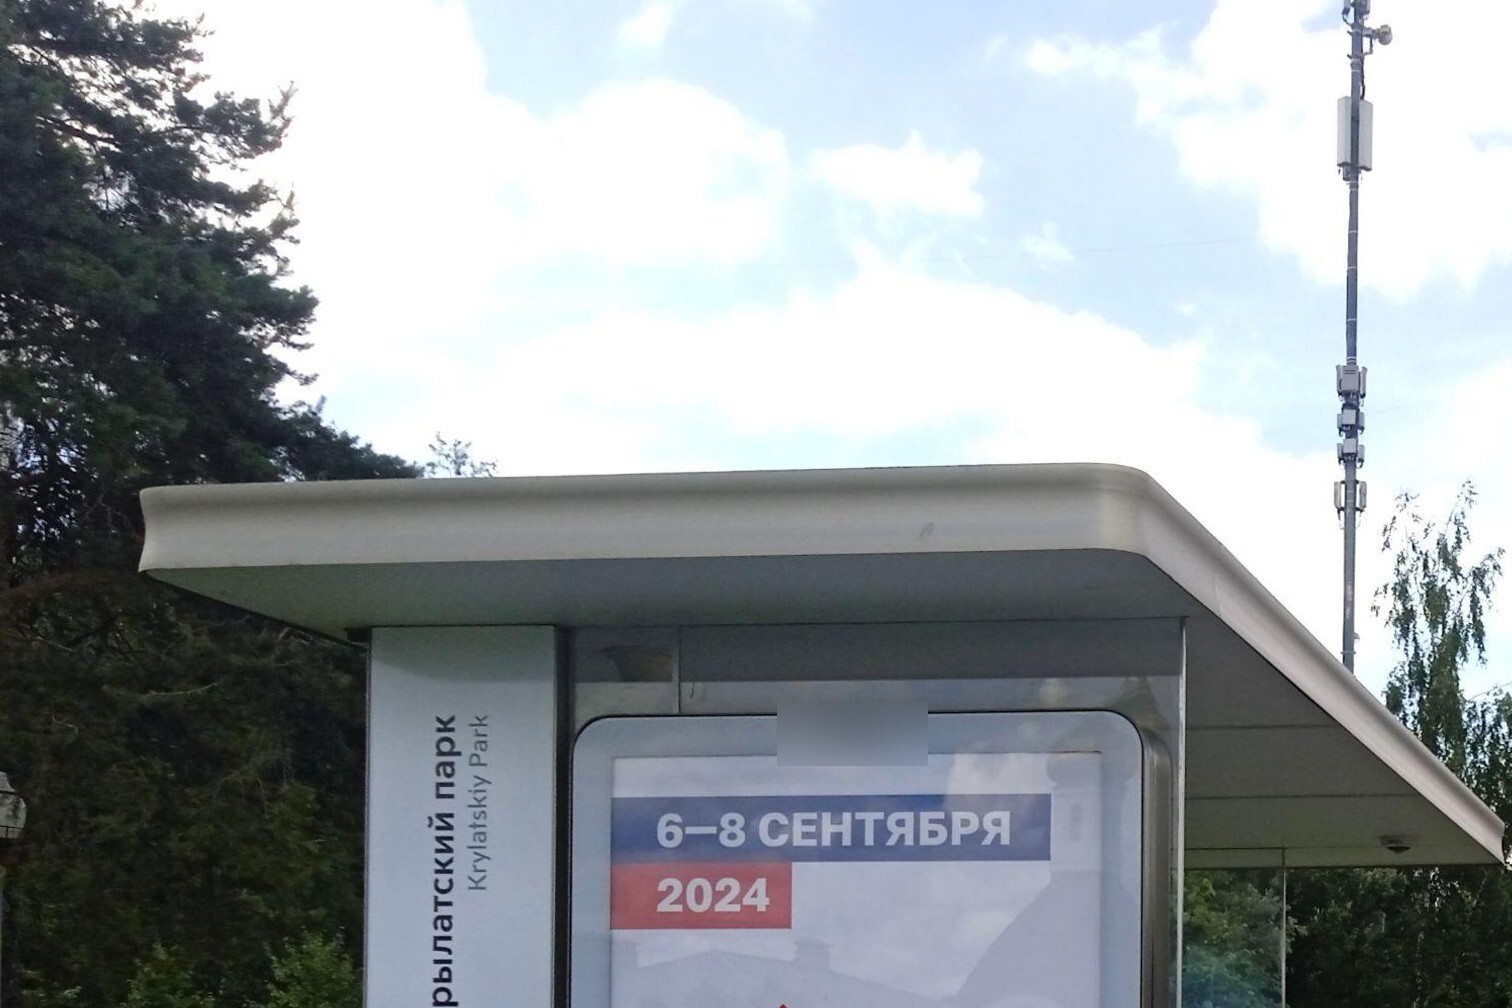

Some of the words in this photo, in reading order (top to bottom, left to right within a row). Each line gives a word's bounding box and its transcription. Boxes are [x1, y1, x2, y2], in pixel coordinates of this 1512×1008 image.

[434, 714, 462, 799] парк
[468, 713, 489, 767] Park
[467, 774, 492, 891] Krylatskiy
[758, 810, 1011, 848] СЕНТЯБРЯ
[656, 877, 770, 913] 2024
